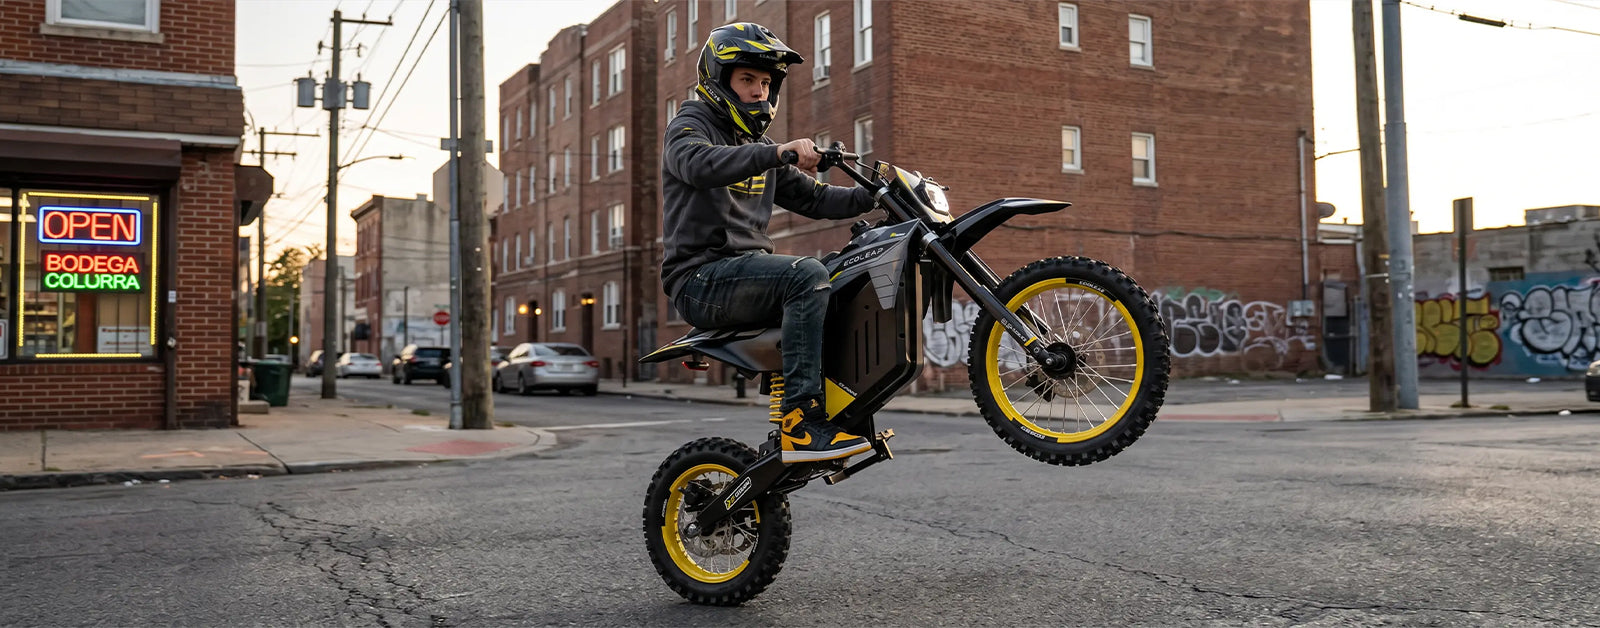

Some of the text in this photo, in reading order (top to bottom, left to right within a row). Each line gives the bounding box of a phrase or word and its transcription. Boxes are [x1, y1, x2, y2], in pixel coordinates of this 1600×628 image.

[44, 211, 135, 241] OPEN
[46, 254, 139, 273] BODEGA
[843, 247, 884, 267] ECOLEAP
[45, 272, 140, 290] COLURRA
